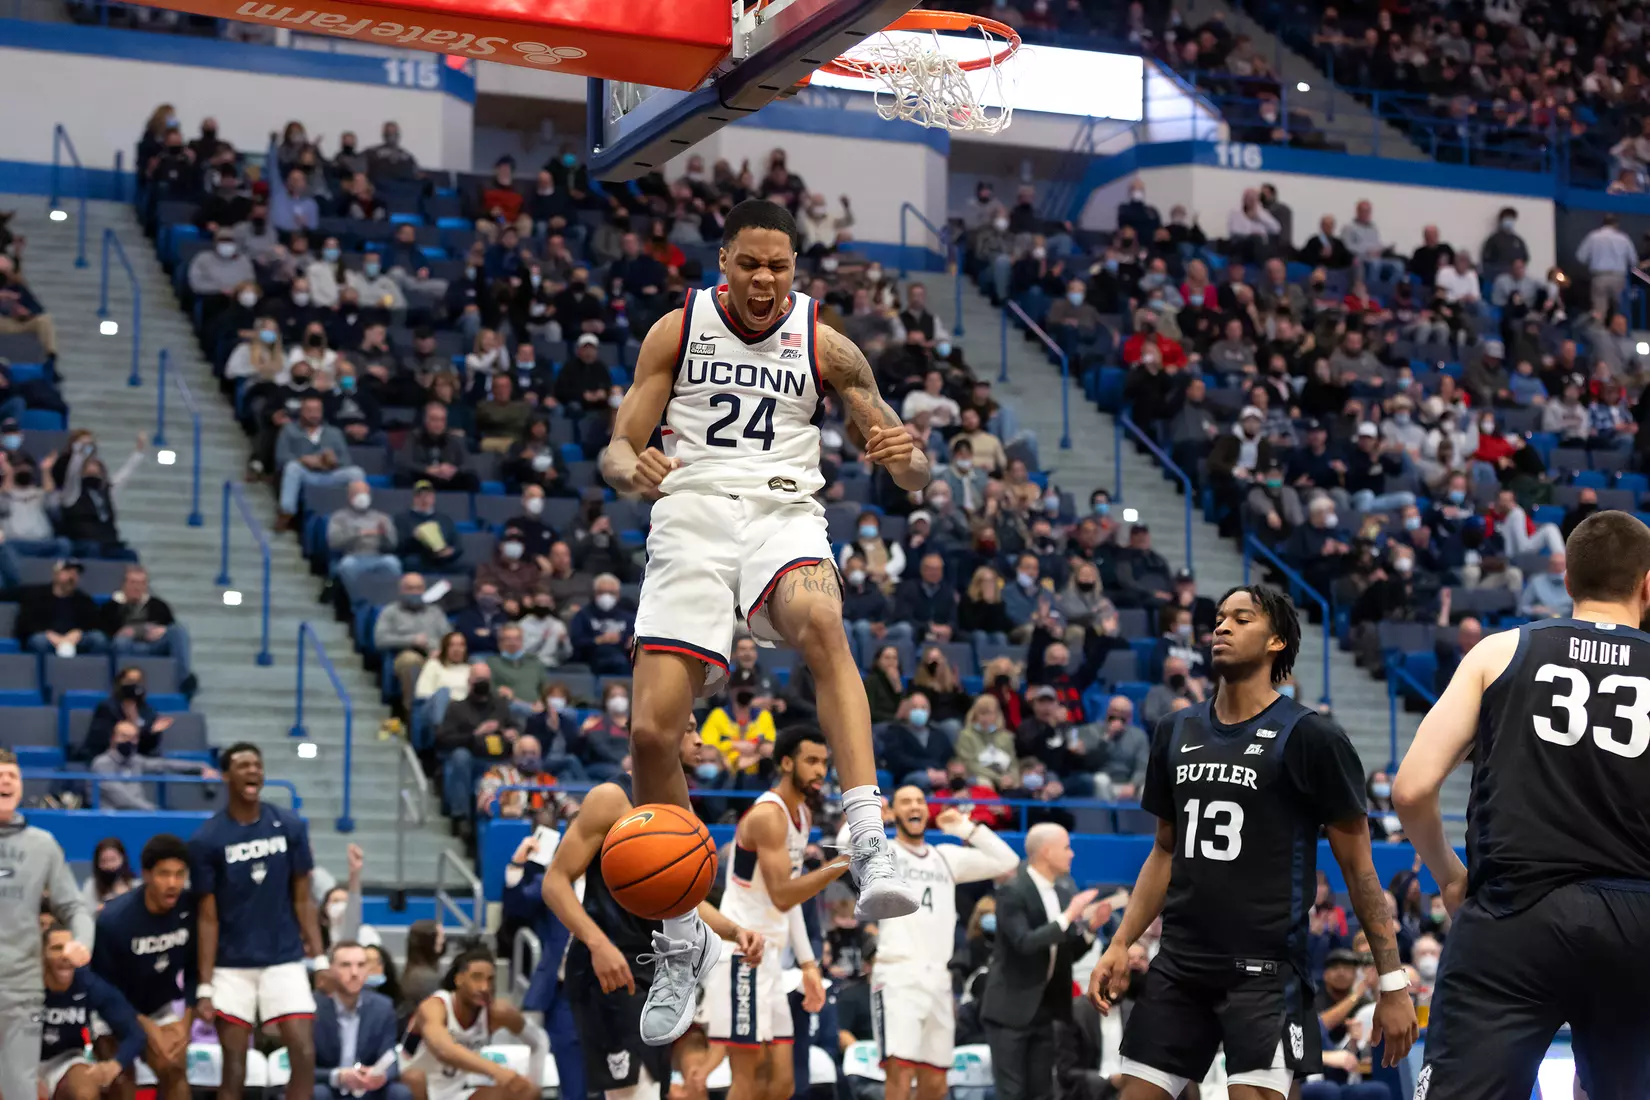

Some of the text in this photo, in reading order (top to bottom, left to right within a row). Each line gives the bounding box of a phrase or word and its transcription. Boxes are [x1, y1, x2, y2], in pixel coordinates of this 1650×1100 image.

[384, 60, 440, 88] 115
[1215, 143, 1263, 170] 116
[687, 359, 806, 397] UCONN
[706, 393, 777, 451] 24
[1569, 636, 1631, 666] GOLDEN
[1533, 663, 1650, 758] 33
[1176, 763, 1258, 790] BUTLER
[1184, 798, 1245, 862] 13
